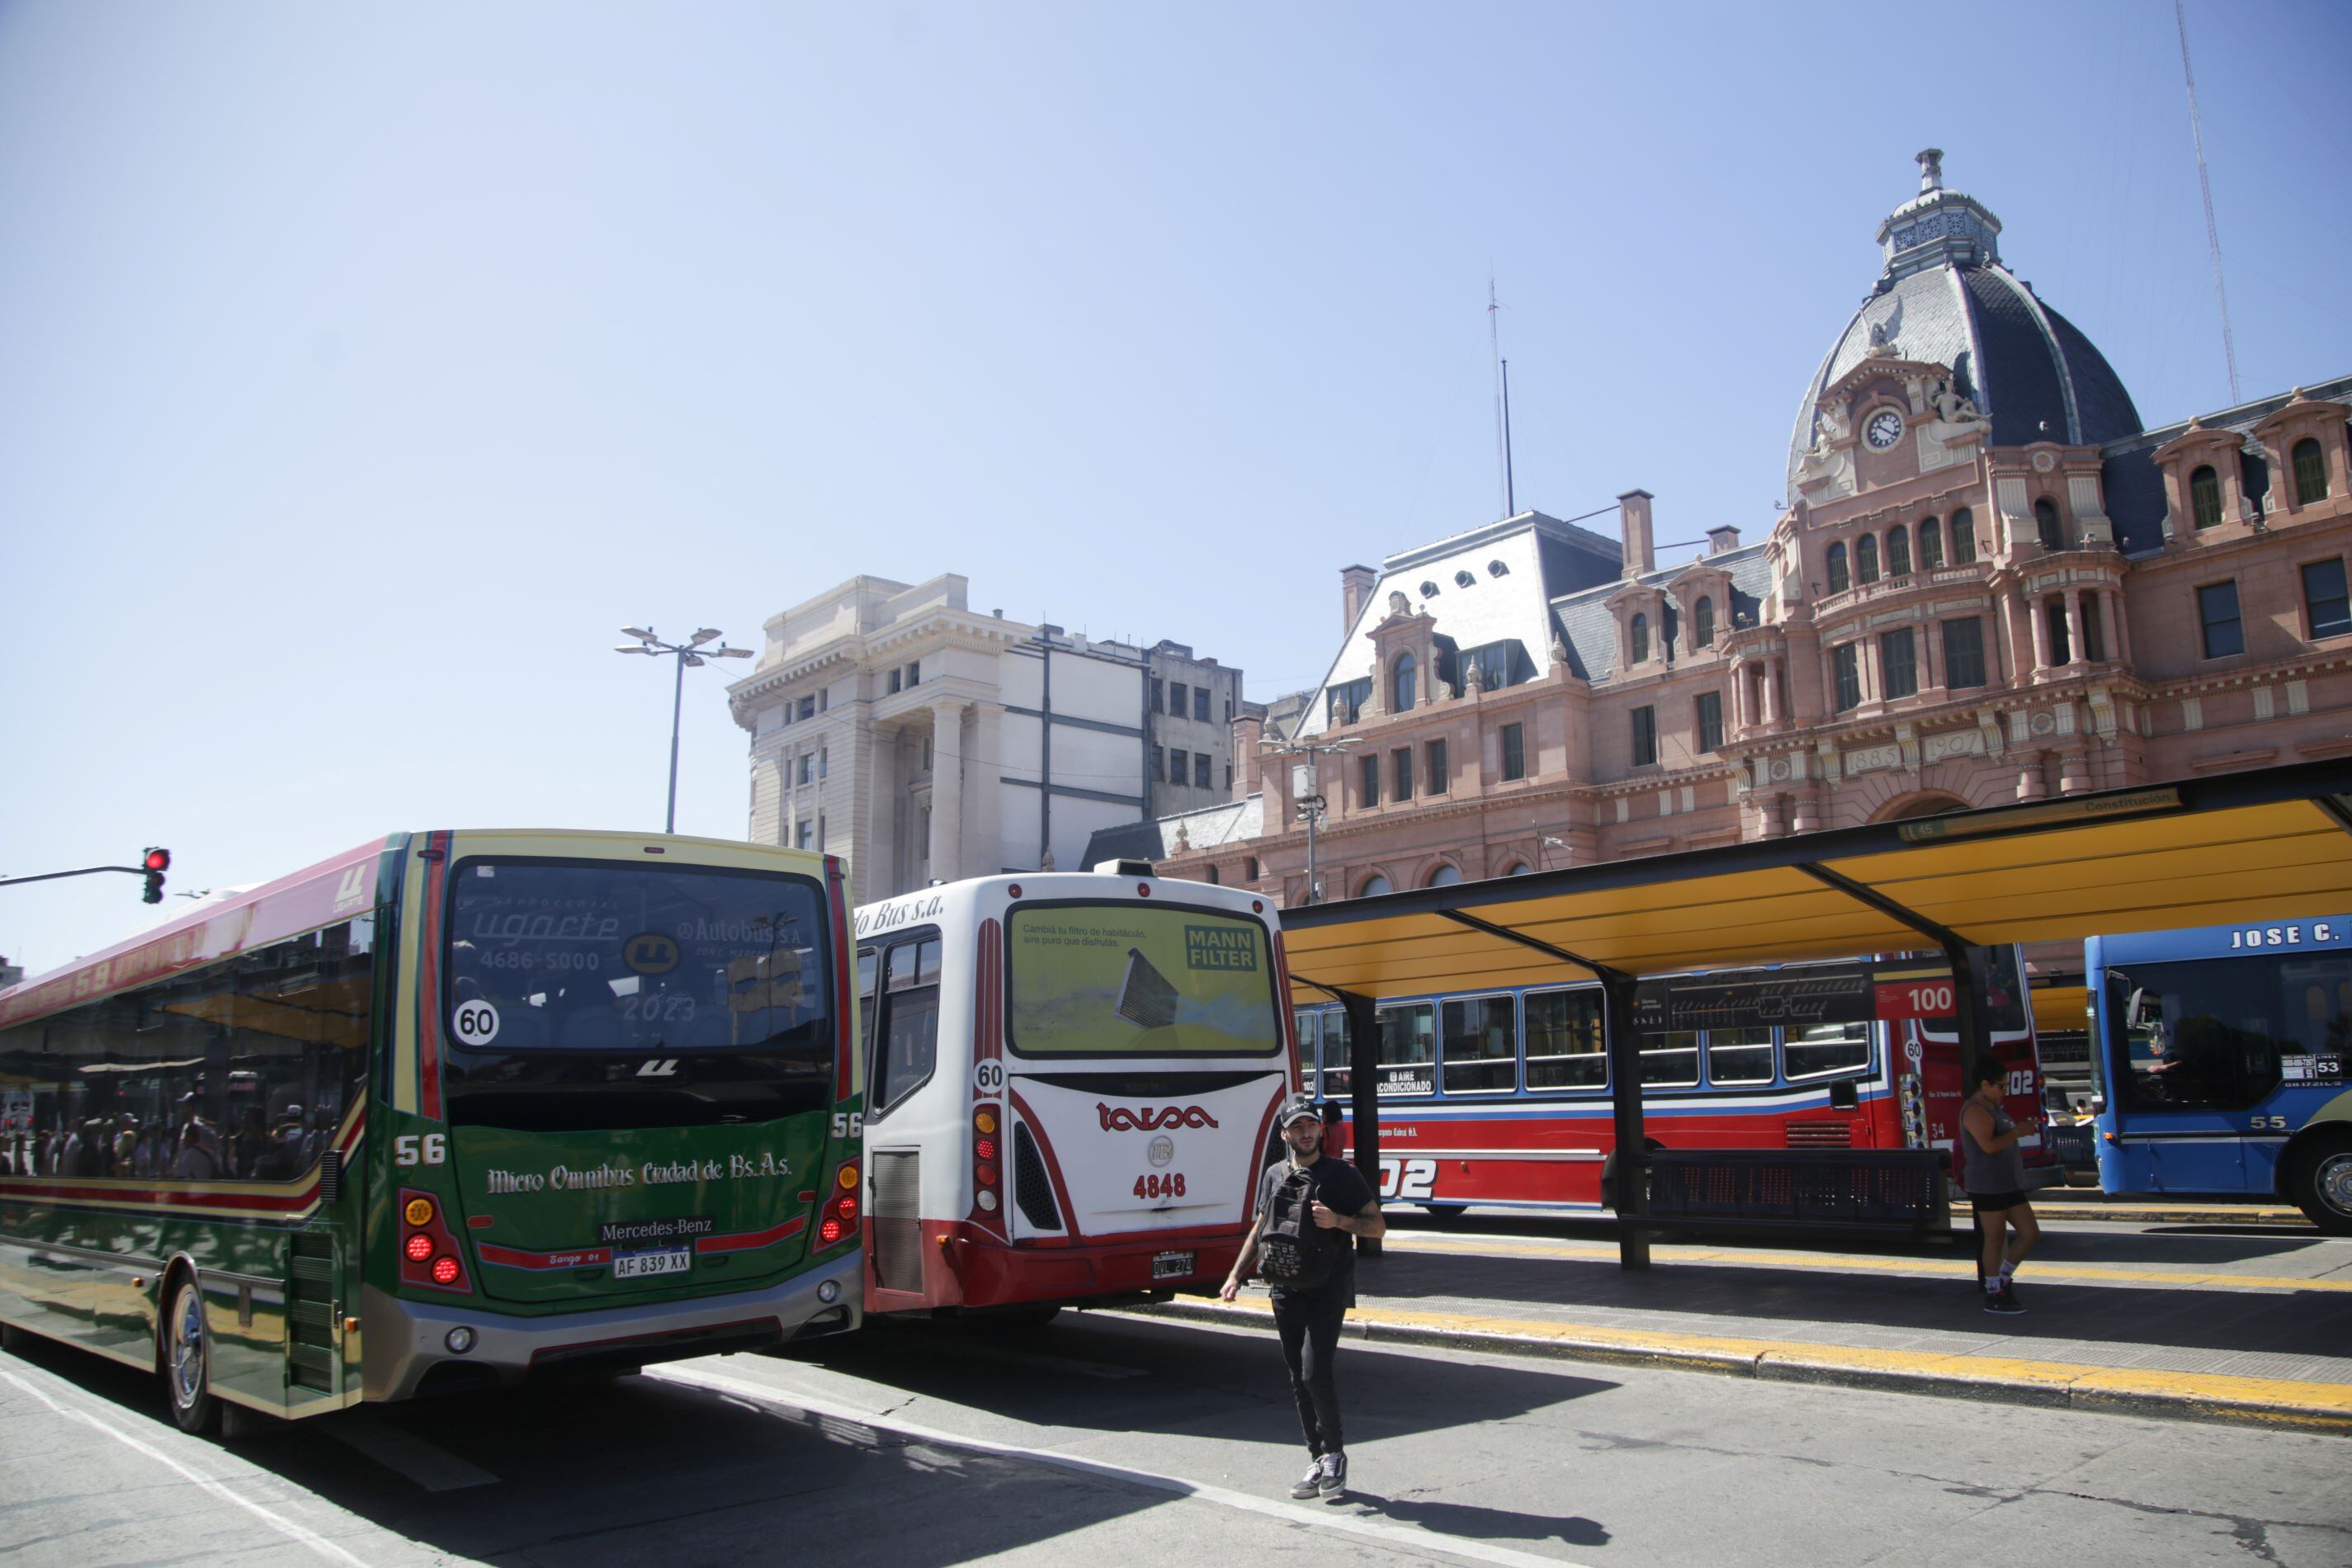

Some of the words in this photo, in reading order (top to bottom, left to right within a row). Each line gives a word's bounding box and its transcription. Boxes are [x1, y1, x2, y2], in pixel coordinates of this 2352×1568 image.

[1929, 732, 1978, 758] 1907
[1848, 748, 1896, 770] 1885
[2085, 794, 2170, 812] Constitución
[871, 902, 910, 931] Bus
[910, 895, 944, 920] s.a.
[696, 917, 775, 942] Autobus
[1023, 923, 1056, 934] Cambiá
[1058, 926, 1067, 935] tu
[1069, 926, 1088, 936] filtro
[1089, 928, 1101, 937] de
[1103, 928, 1147, 939] habitáculo,
[1023, 935, 1040, 944] aire
[1041, 937, 1062, 946] puro
[1064, 937, 1080, 946] que
[1188, 930, 1252, 949] MANN
[2231, 926, 2301, 949] JOSE
[2313, 923, 2340, 942] C.
[479, 952, 600, 971] 4686-5000
[1190, 948, 1254, 966] FILTER
[623, 994, 696, 1022] 2023
[1908, 986, 1953, 1012] 100
[460, 1008, 494, 1036] 60
[1907, 1043, 1921, 1057] 60
[978, 1065, 1003, 1087] 60
[1398, 1070, 1415, 1082] AIRE
[2317, 1061, 2340, 1073] 53
[1302, 1080, 1315, 1092] 102
[832, 1112, 862, 1139] 56
[2250, 1116, 2287, 1129] 55
[394, 1133, 446, 1167] 56
[488, 1169, 545, 1194] Micro
[549, 1164, 635, 1190] Omnibus
[641, 1159, 700, 1185] Ciudad
[702, 1159, 725, 1180] de
[1133, 1173, 1186, 1199] 4848
[602, 1218, 712, 1241] Mercedes-Benz
[618, 1259, 635, 1276] AF
[640, 1255, 666, 1273] 839
[670, 1253, 687, 1269] XX
